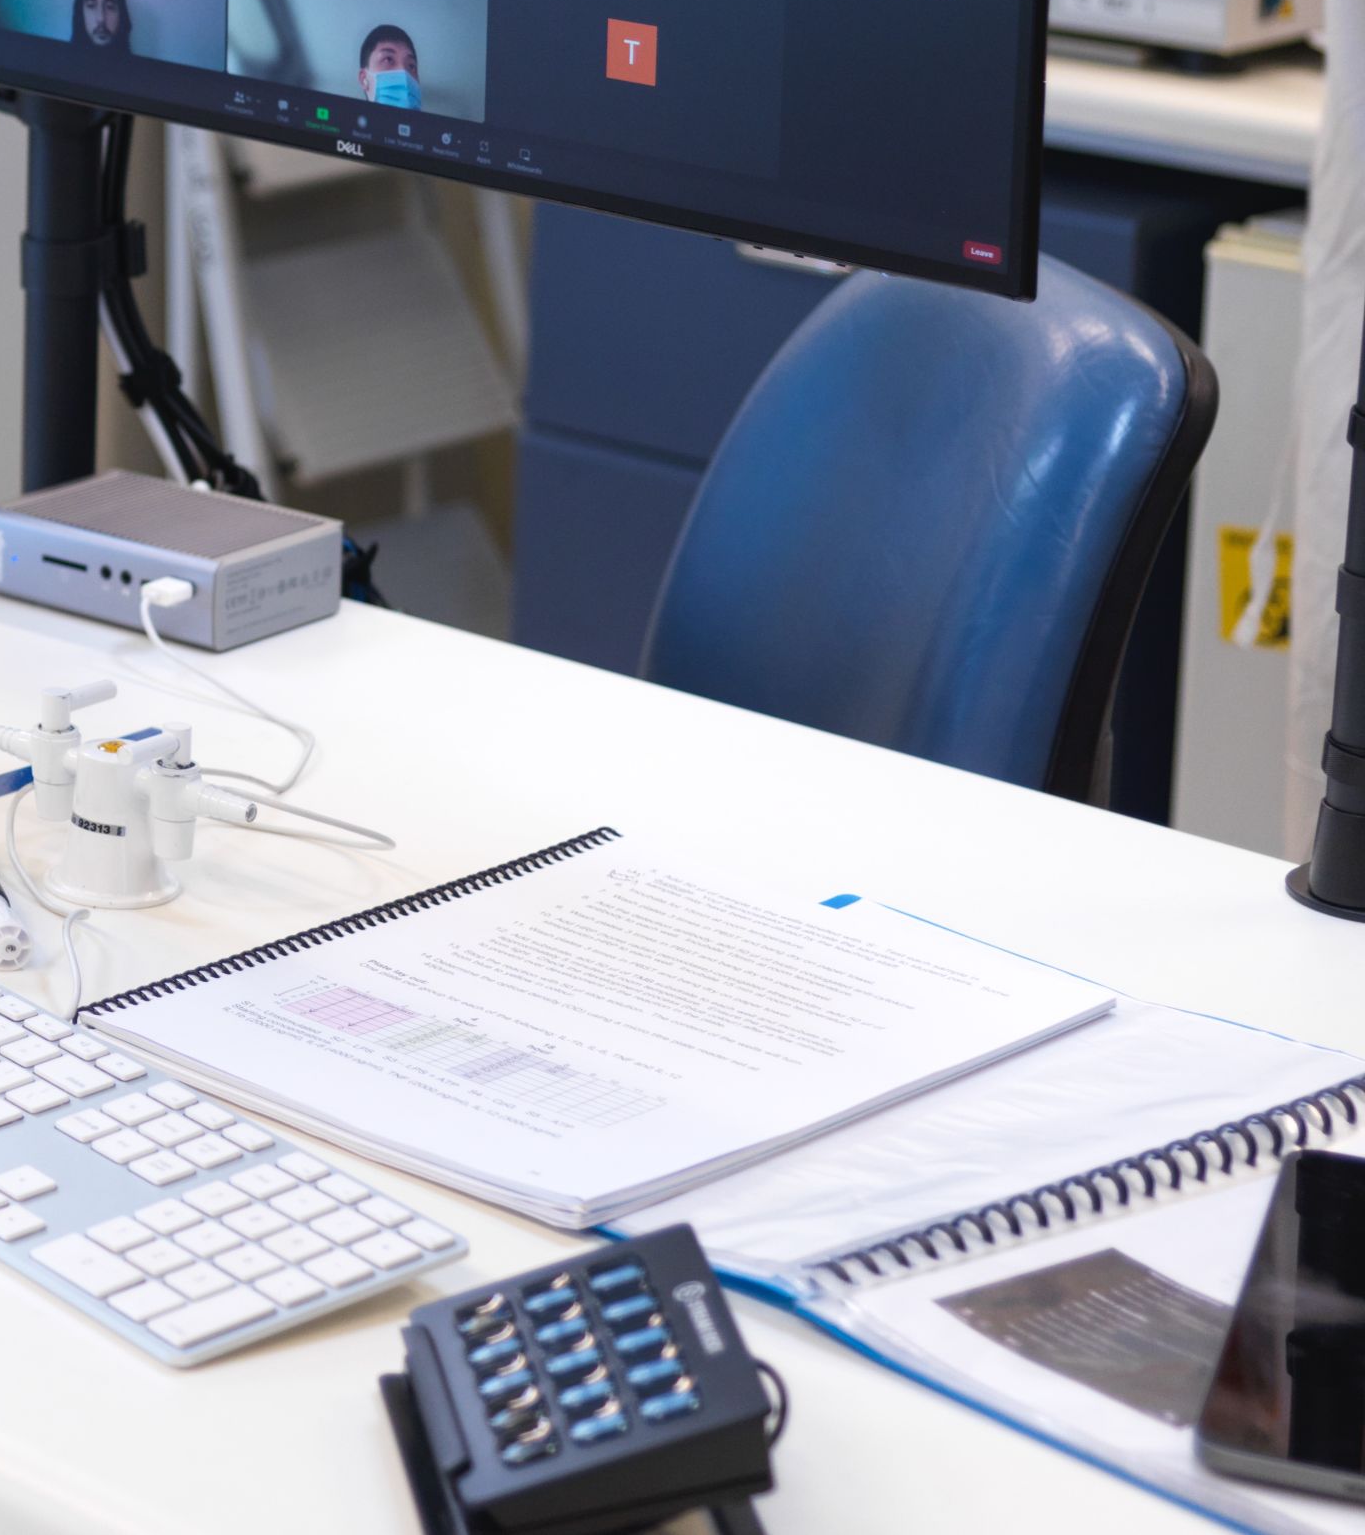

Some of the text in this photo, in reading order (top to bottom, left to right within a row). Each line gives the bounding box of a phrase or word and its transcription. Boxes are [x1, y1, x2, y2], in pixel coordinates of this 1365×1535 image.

[622, 39, 642, 66] T
[337, 140, 364, 157] DELL
[971, 247, 994, 258] Leave
[78, 817, 111, 835] 92313
